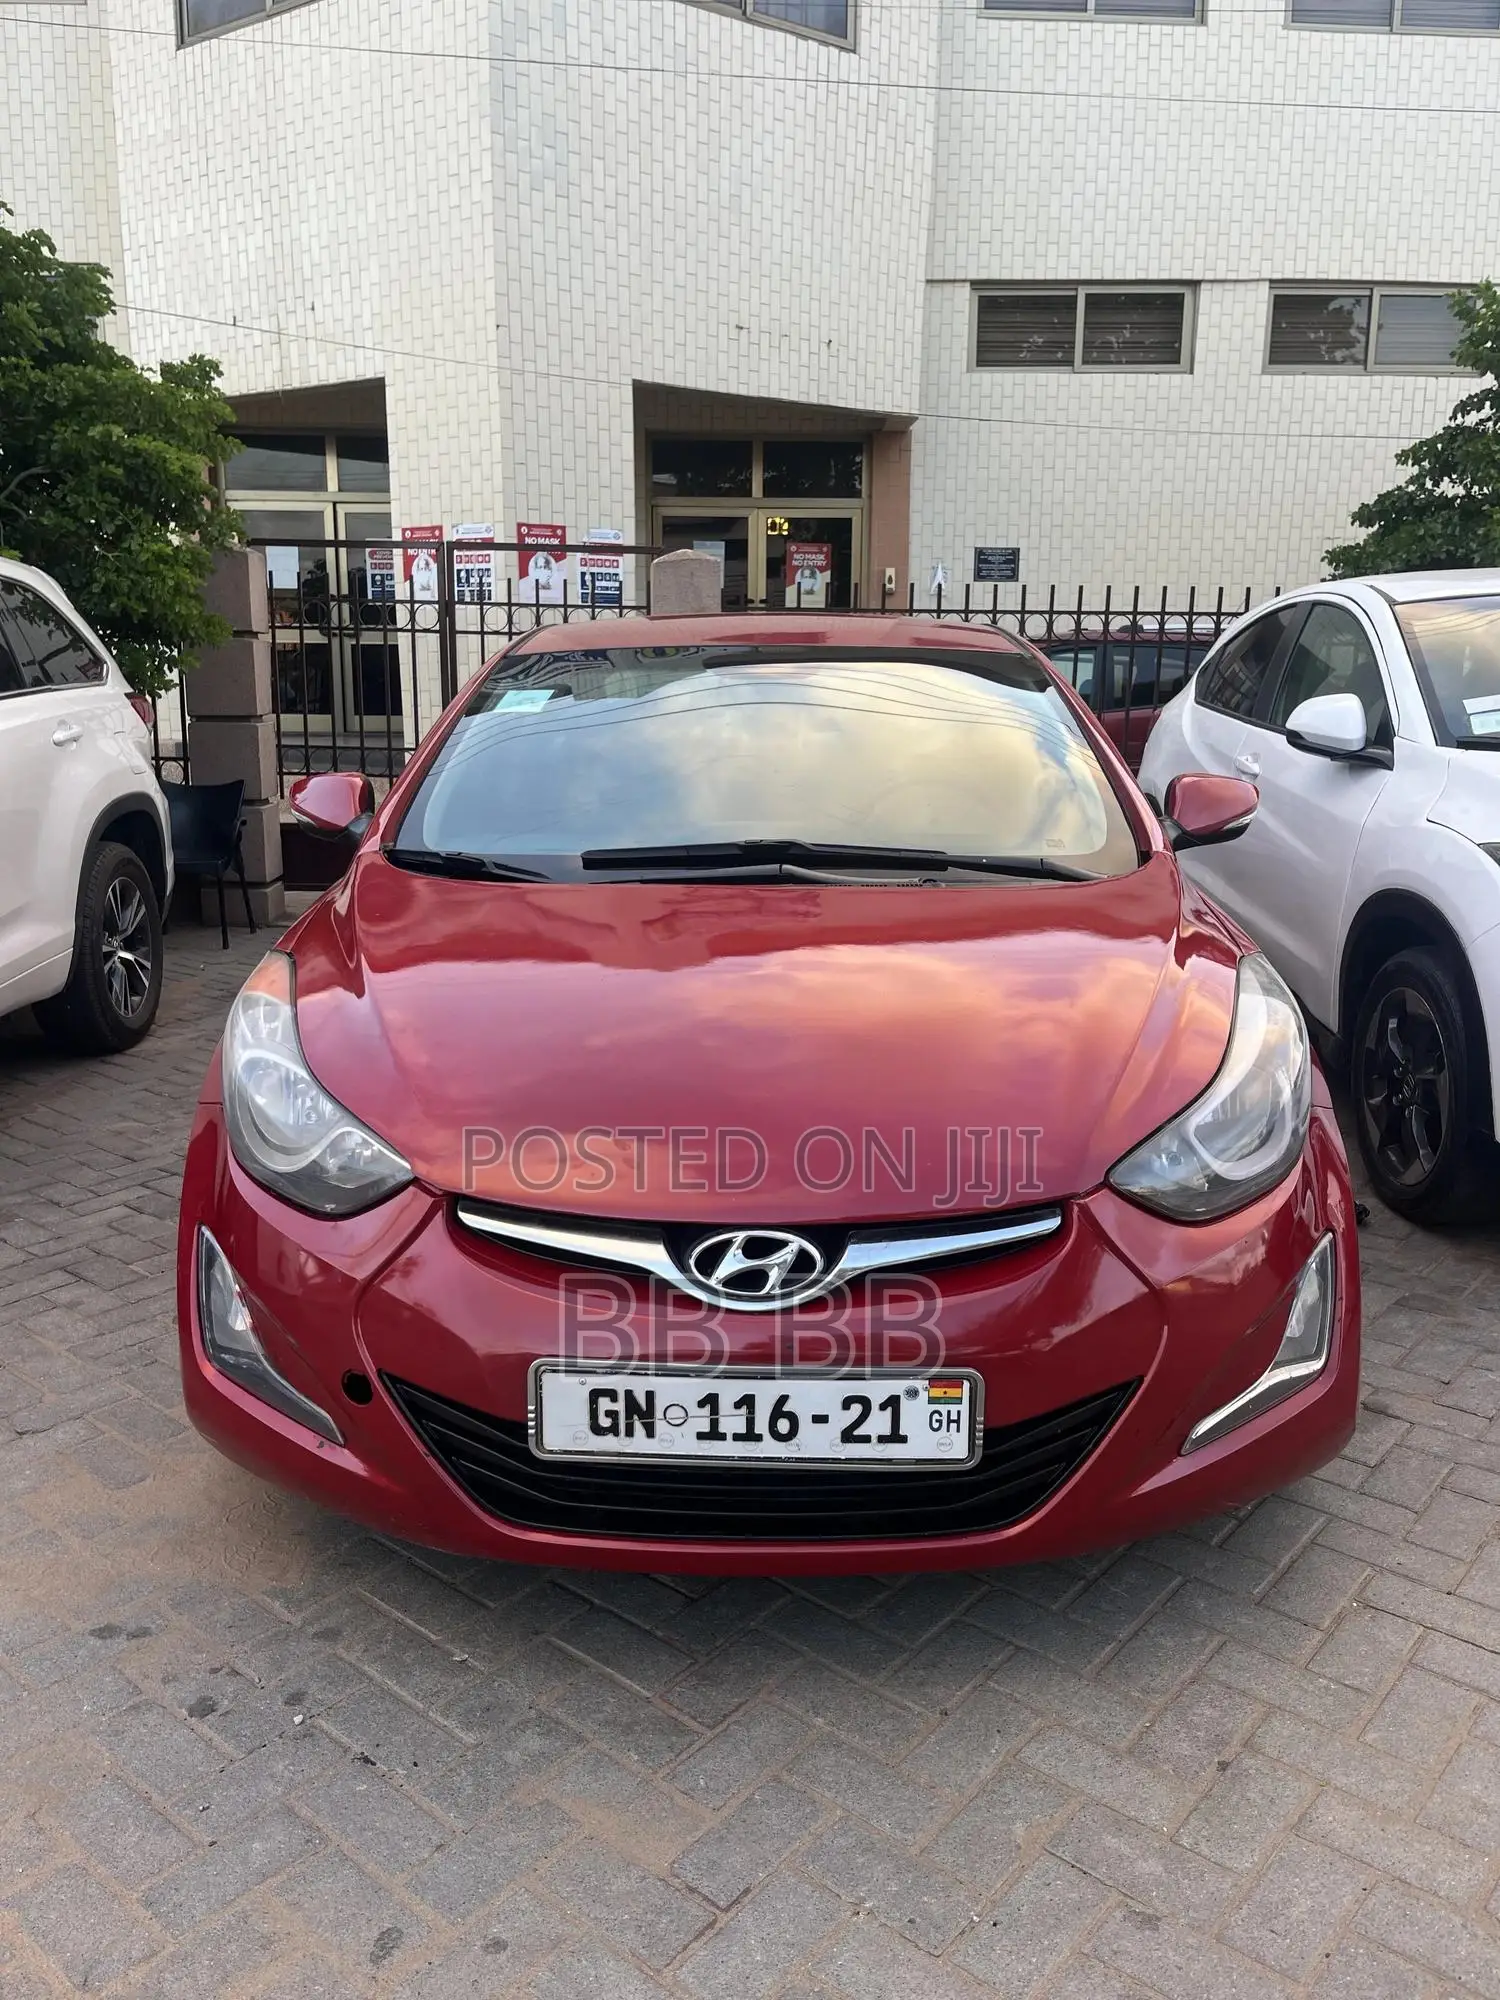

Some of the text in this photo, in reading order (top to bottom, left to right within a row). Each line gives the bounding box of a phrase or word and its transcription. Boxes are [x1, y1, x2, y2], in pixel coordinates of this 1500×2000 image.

[538, 537, 560, 545] MASK
[588, 1388, 655, 1438] GN
[928, 1409, 961, 1433] GH
